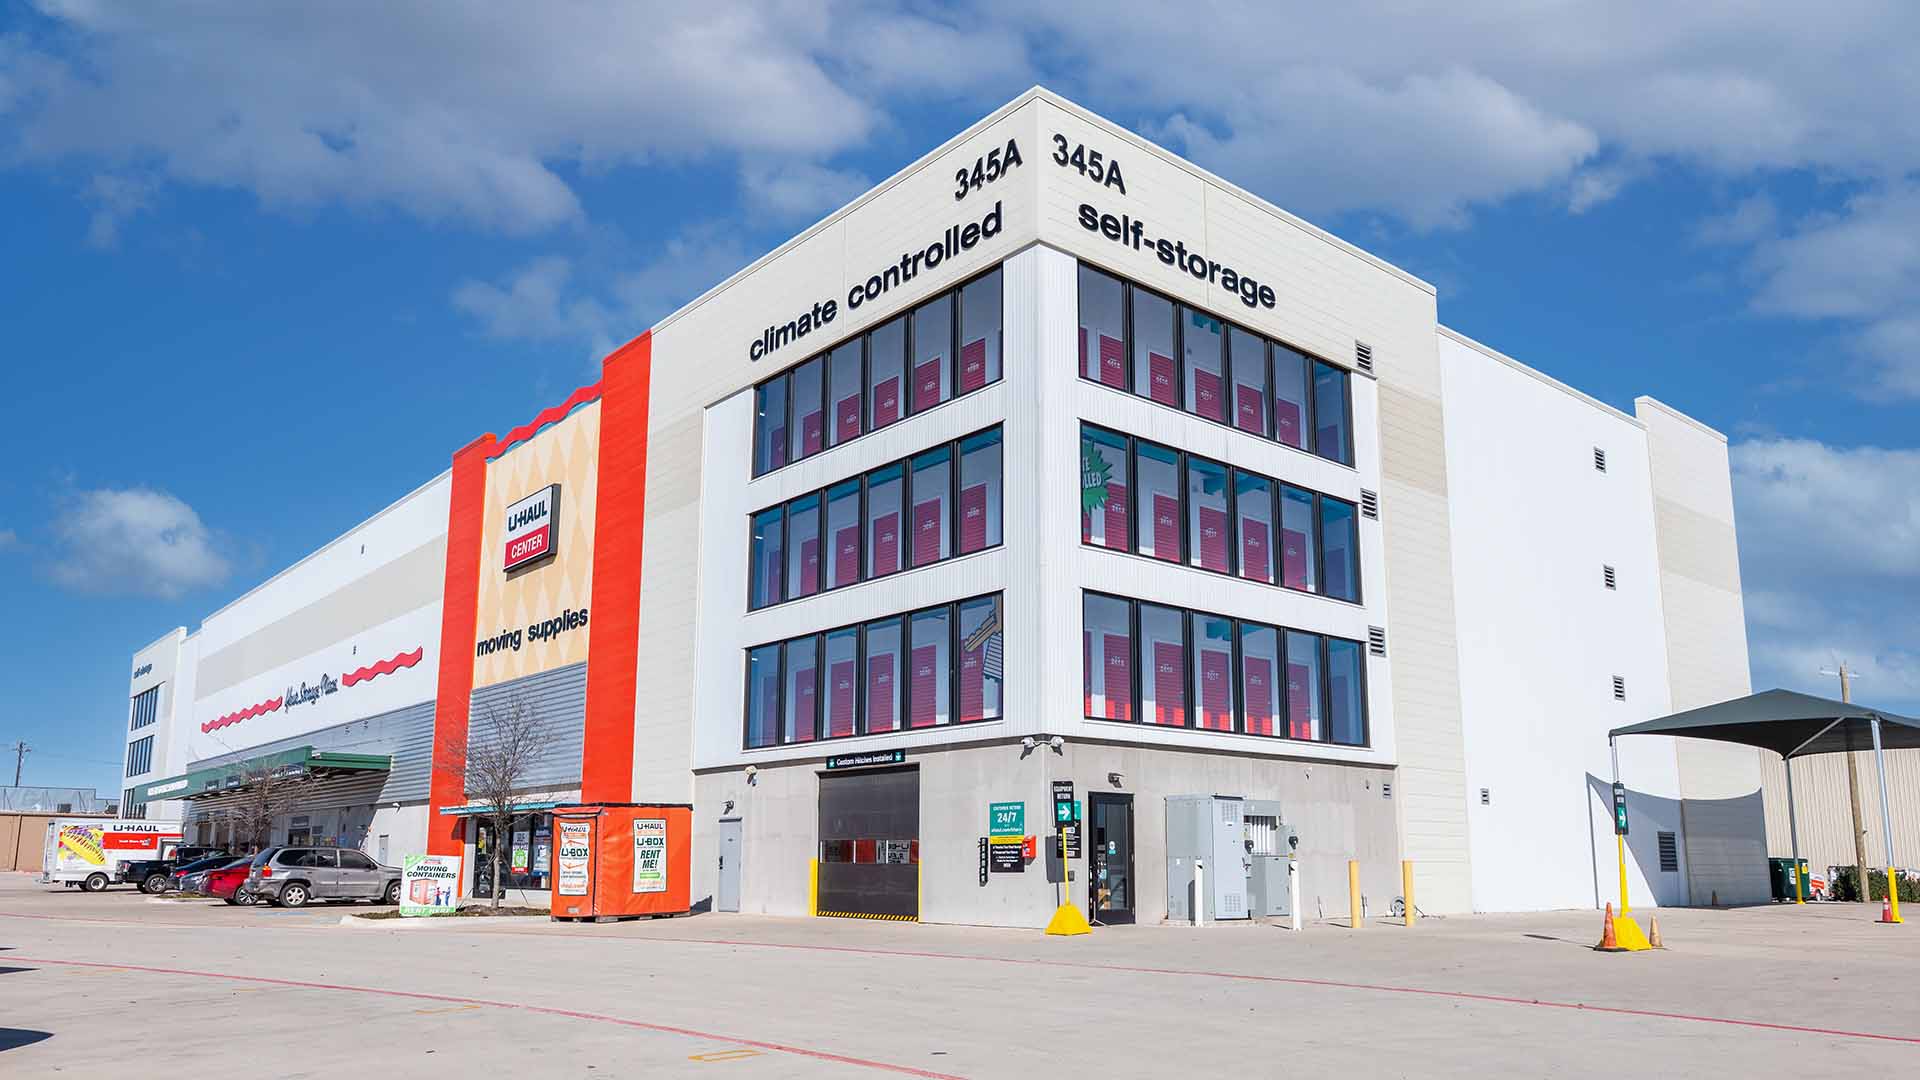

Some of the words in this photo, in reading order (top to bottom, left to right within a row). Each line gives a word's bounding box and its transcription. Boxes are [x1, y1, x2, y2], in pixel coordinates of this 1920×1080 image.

[955, 138, 1023, 201] 345A
[1052, 132, 1126, 195] 345A
[1077, 203, 1277, 309] self-storage
[749, 298, 837, 362] climate
[848, 200, 1003, 310] controlled
[508, 500, 548, 532] U-HAUL
[511, 533, 543, 559] CENTER
[477, 629, 522, 656] moving
[528, 608, 588, 642] supplies
[997, 811, 1017, 823] 24/7
[113, 824, 159, 832] U-HAUL
[636, 837, 664, 846] U-BOX
[561, 847, 589, 857] U-BOX
[640, 849, 661, 859] RENT
[642, 859, 658, 869] ME!
[406, 871, 457, 879] CONTAINERS
